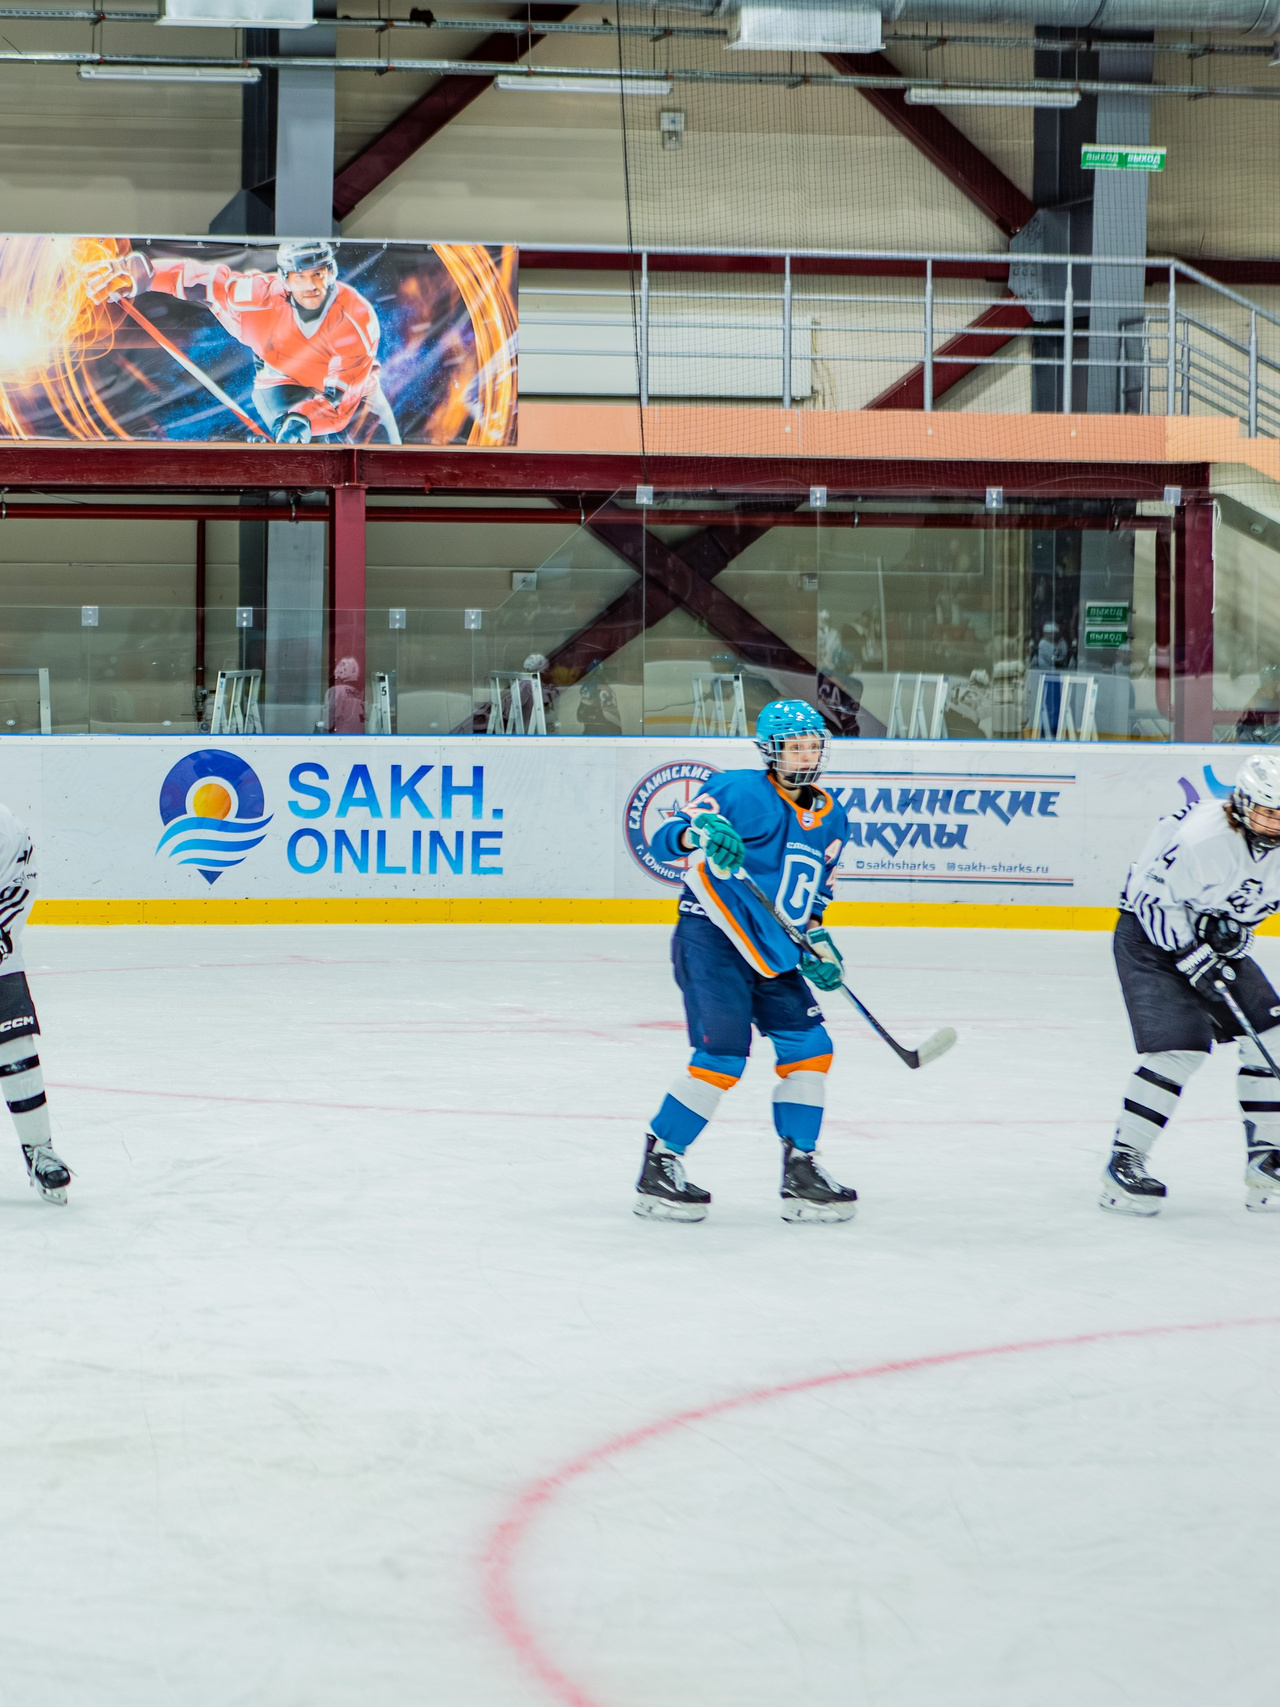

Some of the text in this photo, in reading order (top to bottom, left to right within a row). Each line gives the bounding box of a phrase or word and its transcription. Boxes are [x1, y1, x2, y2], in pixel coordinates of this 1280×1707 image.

[1086, 152, 1119, 163] ВЫХОД
[1127, 153, 1160, 164] ВЫХОД
[287, 762, 504, 820] SAKH.
[628, 765, 712, 830] САХАЛИНСКИЕ
[823, 787, 1061, 826] ХАЛИНСКИЕ
[286, 827, 504, 875] ONLINE
[956, 862, 1049, 873] sakh-sharks.ru
[0, 1015, 34, 1033] CCM
